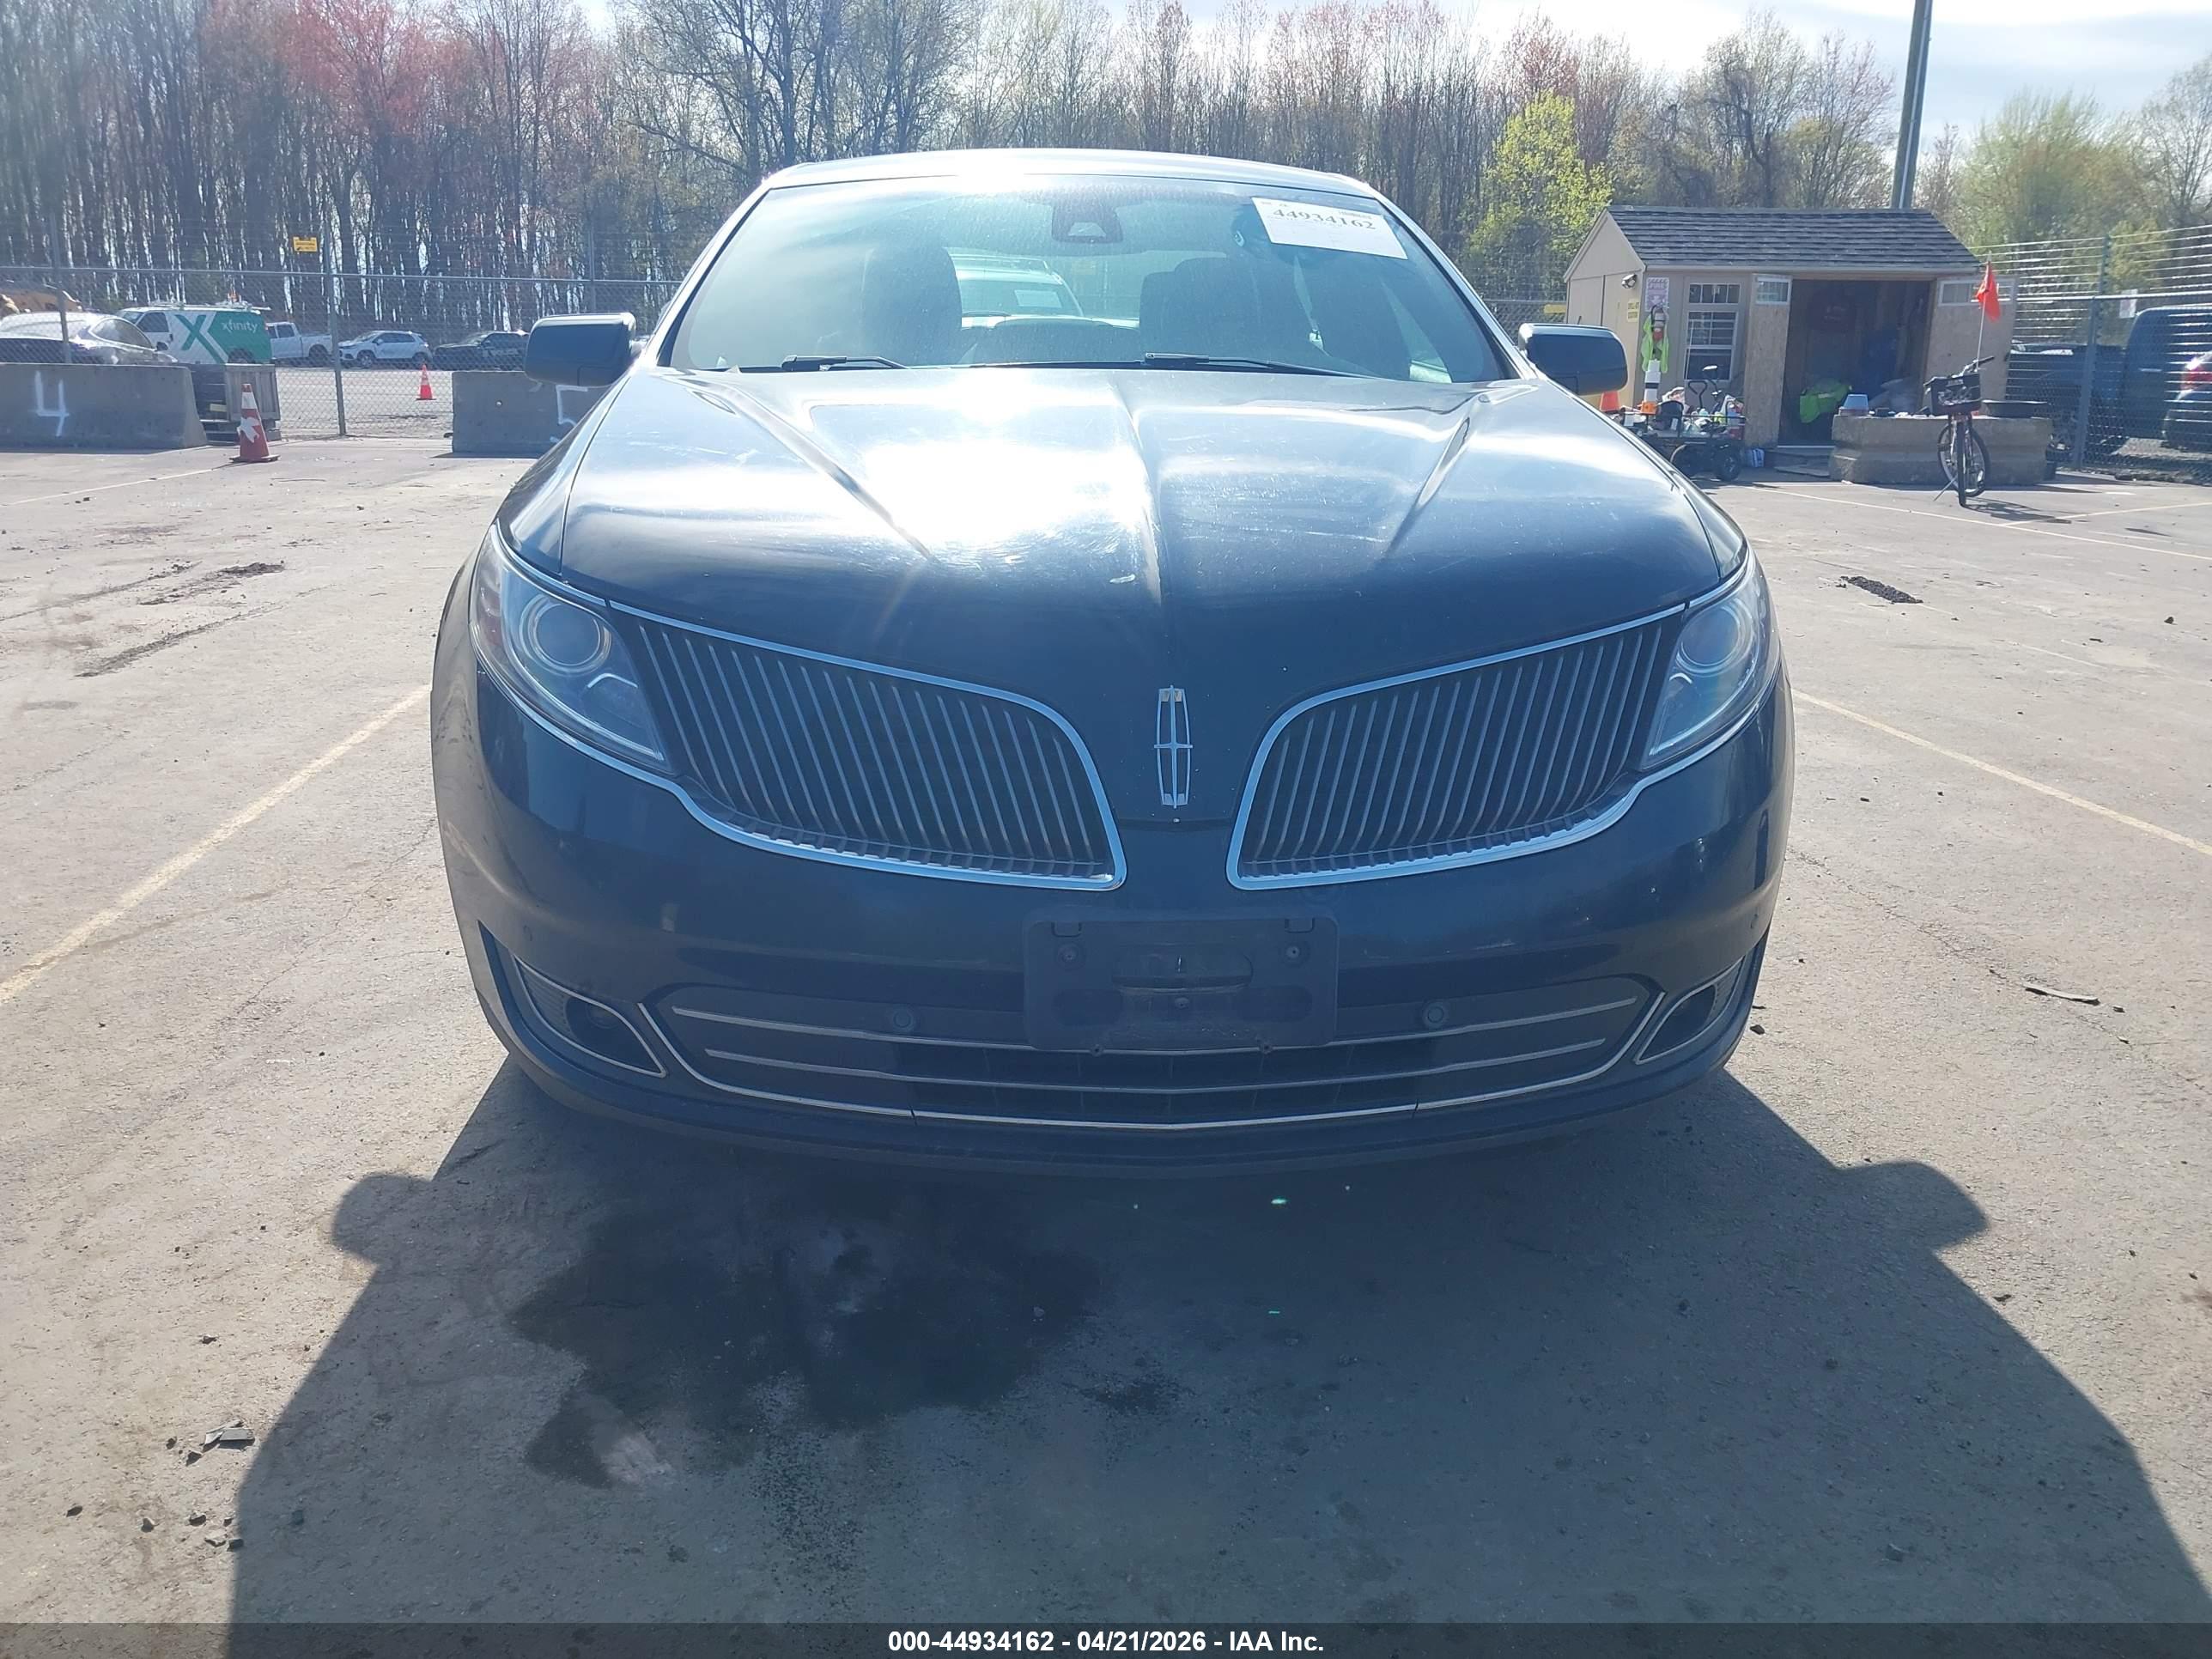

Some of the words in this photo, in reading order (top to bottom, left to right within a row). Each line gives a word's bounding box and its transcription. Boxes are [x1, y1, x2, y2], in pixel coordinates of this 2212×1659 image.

[1273, 209, 1376, 230] 44934162
[222, 319, 258, 333] xfinity
[35, 370, 70, 437] 4
